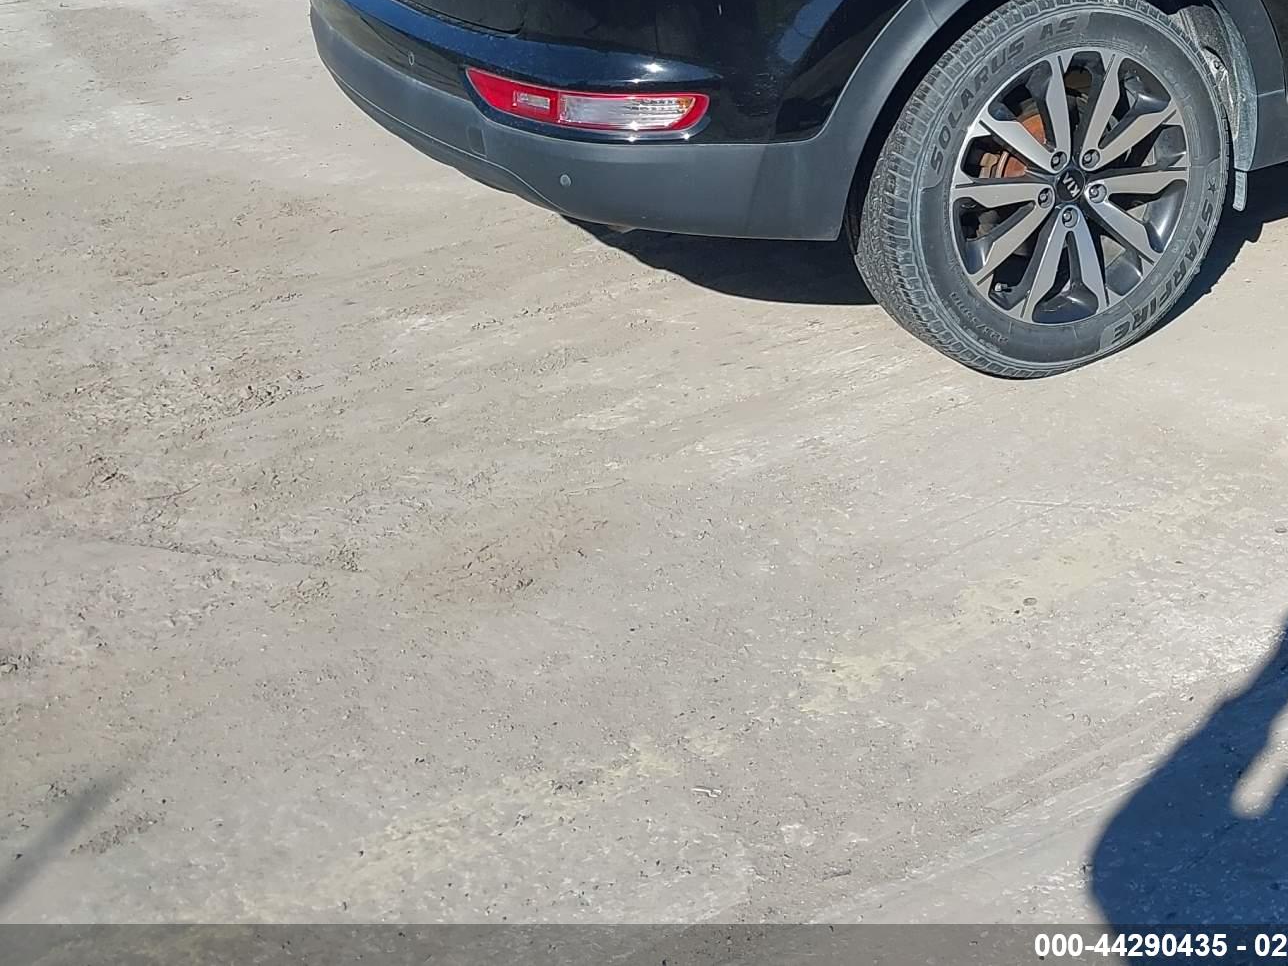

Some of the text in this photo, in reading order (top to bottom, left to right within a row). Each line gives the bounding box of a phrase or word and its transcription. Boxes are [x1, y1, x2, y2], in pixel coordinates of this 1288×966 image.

[930, 15, 1078, 175] SOLARUS AS
[1062, 171, 1080, 198] KIA
[1111, 198, 1214, 345] STARFIRE
